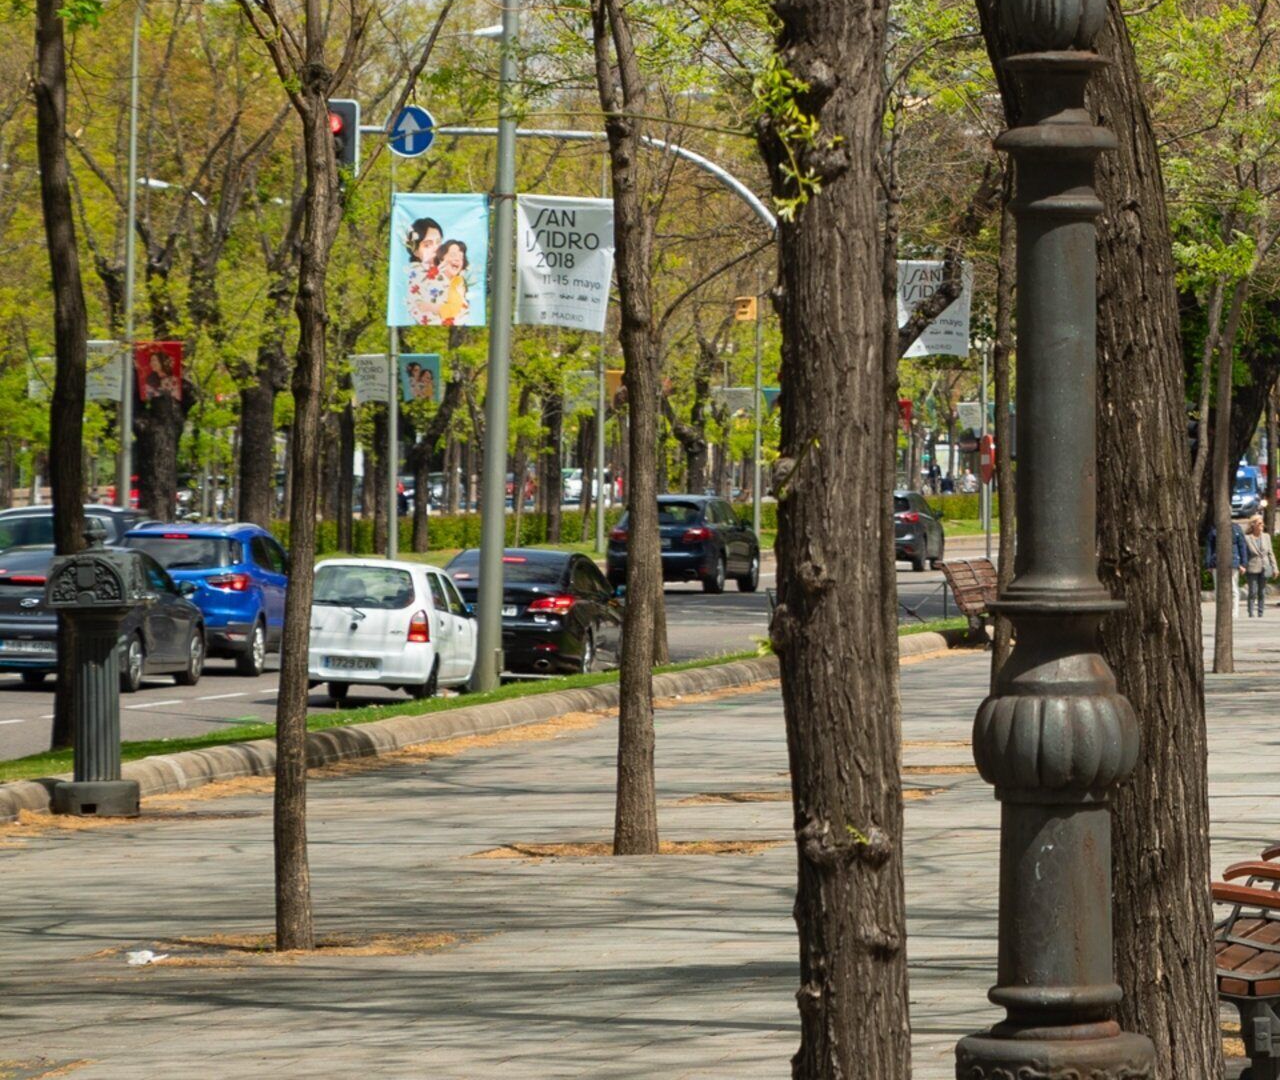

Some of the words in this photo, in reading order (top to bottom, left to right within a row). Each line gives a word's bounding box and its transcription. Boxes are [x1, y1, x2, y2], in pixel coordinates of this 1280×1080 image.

[530, 208, 576, 229] SAN
[526, 230, 600, 252] ISIDRO
[536, 251, 575, 269] 2018
[542, 274, 569, 286] 11-15
[573, 277, 601, 290] mayo
[551, 311, 584, 322] MADRID
